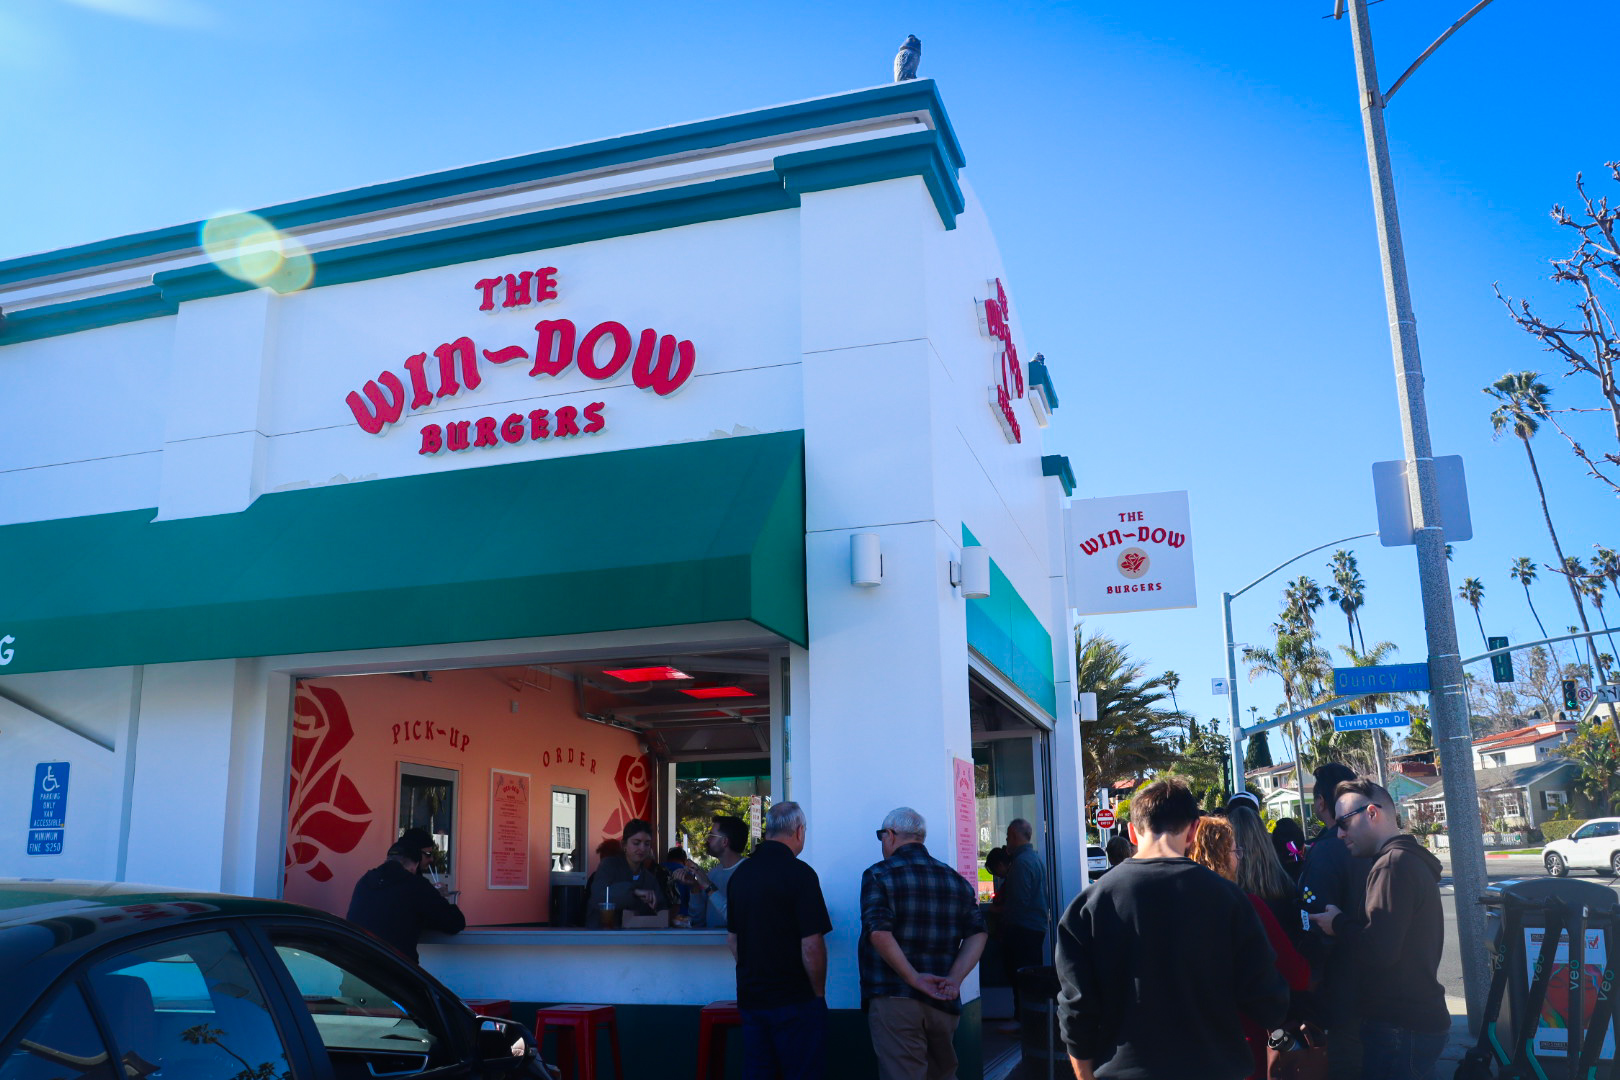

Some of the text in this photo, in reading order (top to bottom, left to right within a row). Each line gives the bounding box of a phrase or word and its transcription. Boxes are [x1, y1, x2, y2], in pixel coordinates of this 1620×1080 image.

[474, 266, 559, 313] THE
[418, 401, 606, 456] BURGERS
[1118, 511, 1144, 522] THE
[1106, 582, 1162, 594] BURGERS
[1339, 672, 1397, 689] Quincy
[1338, 715, 1405, 729] Livingston Dr
[392, 719, 471, 752] PICK-UP
[542, 747, 598, 775] ORDER
[40, 792, 60, 800] PARKING
[42, 801, 56, 809] ONLY
[33, 819, 61, 827] ACCESSIBLE
[34, 832, 58, 841] MINIMUM
[29, 842, 61, 852] FINE $250
[1532, 954, 1545, 982] veo
[1569, 960, 1580, 990] veo
[1597, 969, 1615, 1001] veo
